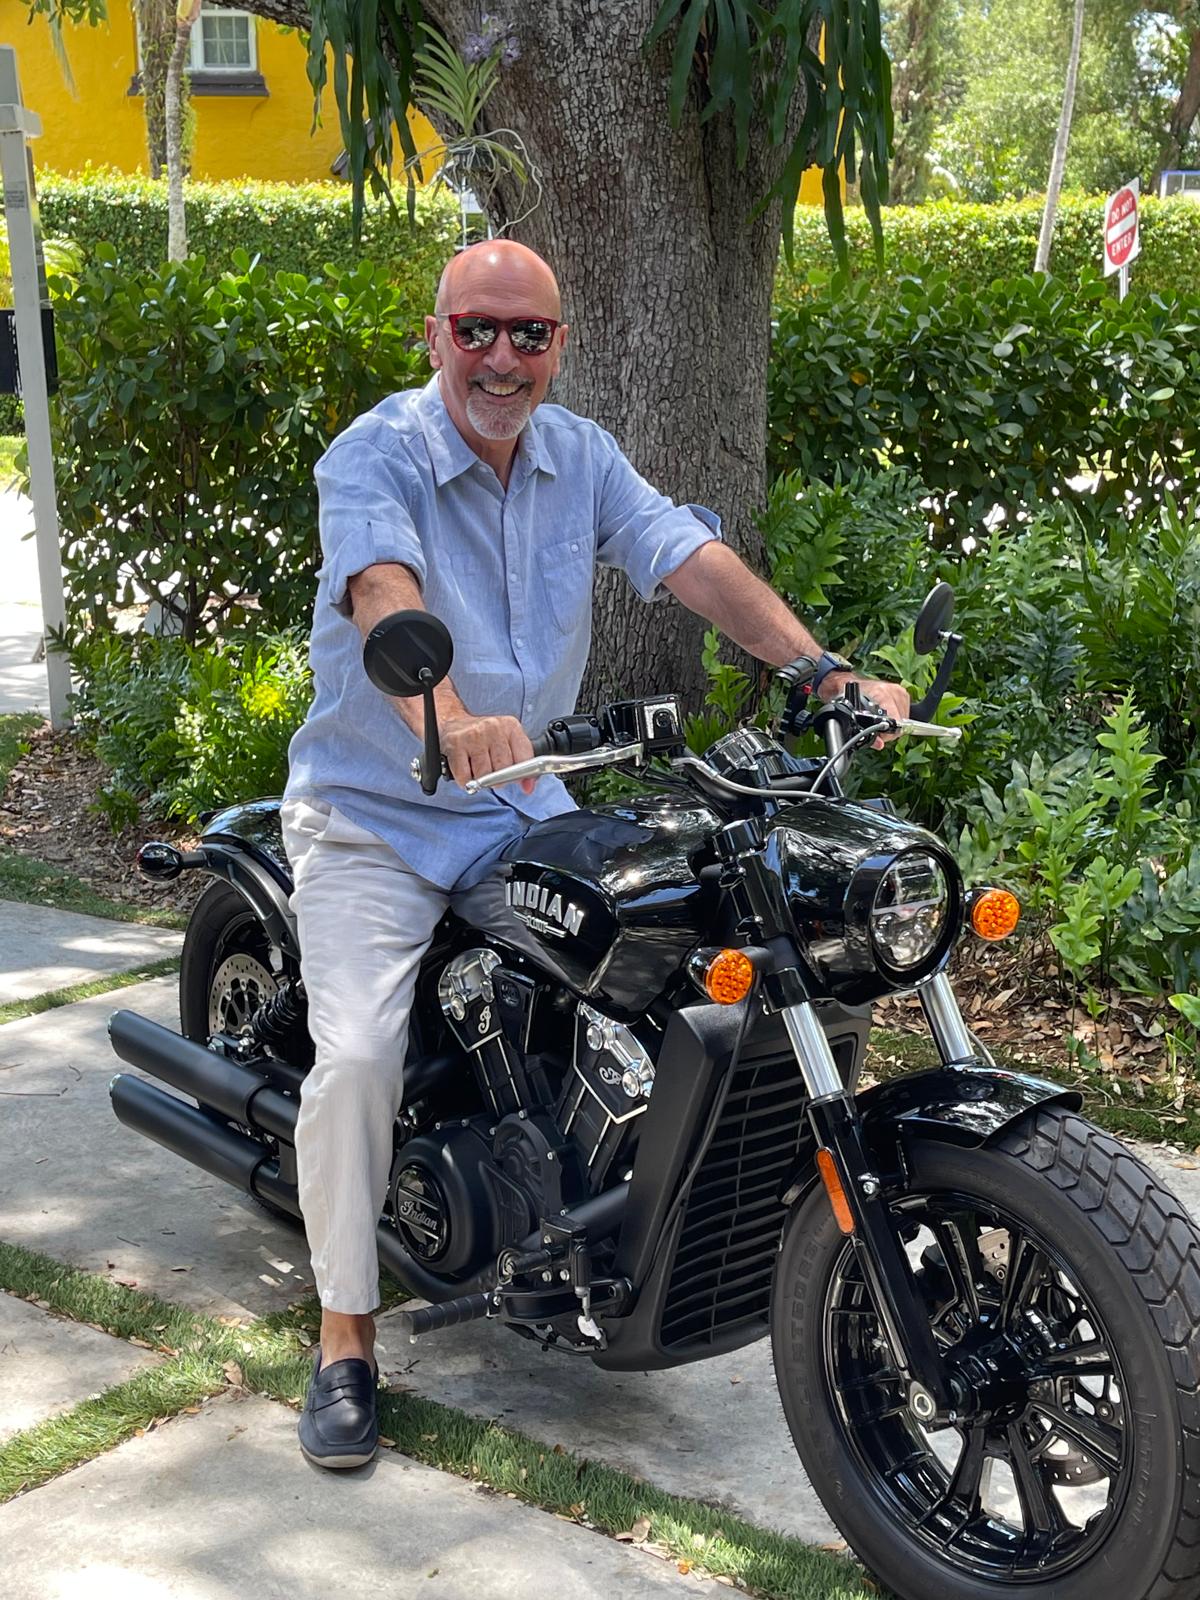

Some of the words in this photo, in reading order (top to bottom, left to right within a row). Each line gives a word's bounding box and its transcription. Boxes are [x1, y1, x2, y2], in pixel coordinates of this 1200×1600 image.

[1111, 207, 1120, 224] DO
[1121, 197, 1133, 217] NOT
[1111, 231, 1132, 257] ENTER
[505, 881, 584, 936] INDIAN
[400, 1200, 438, 1231] Indian
